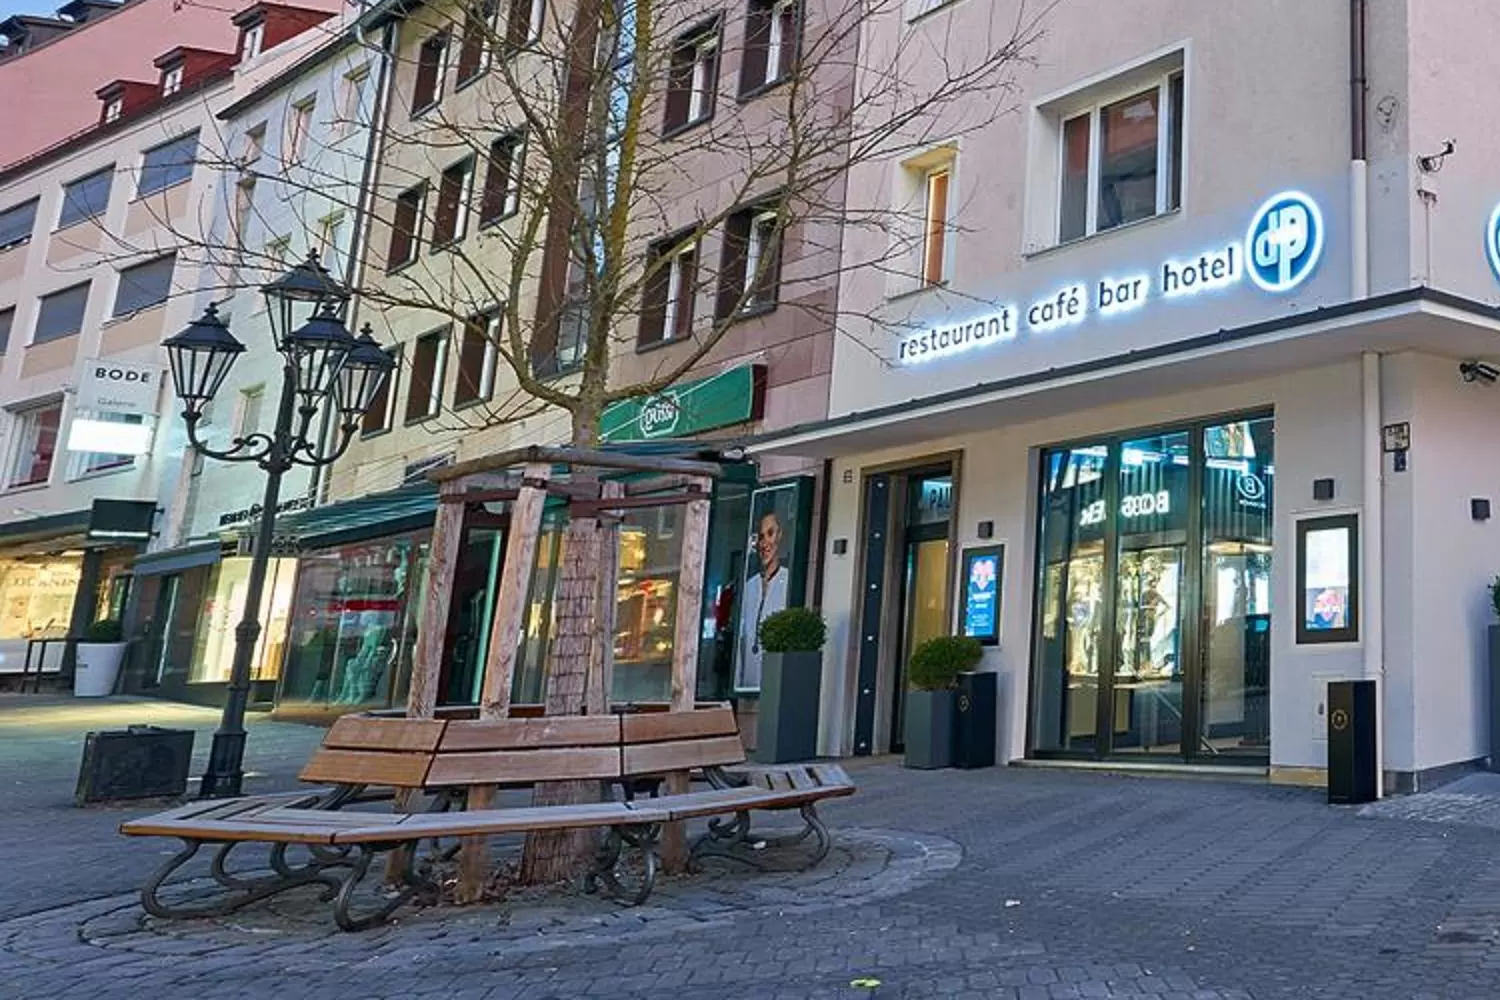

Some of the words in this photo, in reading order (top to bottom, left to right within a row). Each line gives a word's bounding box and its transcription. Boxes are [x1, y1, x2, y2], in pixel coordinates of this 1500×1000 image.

[898, 308, 1011, 359] restaurant
[1027, 287, 1080, 325] café
[1098, 279, 1142, 308] bar
[1162, 246, 1234, 292] hotel
[95, 367, 152, 383] BODE
